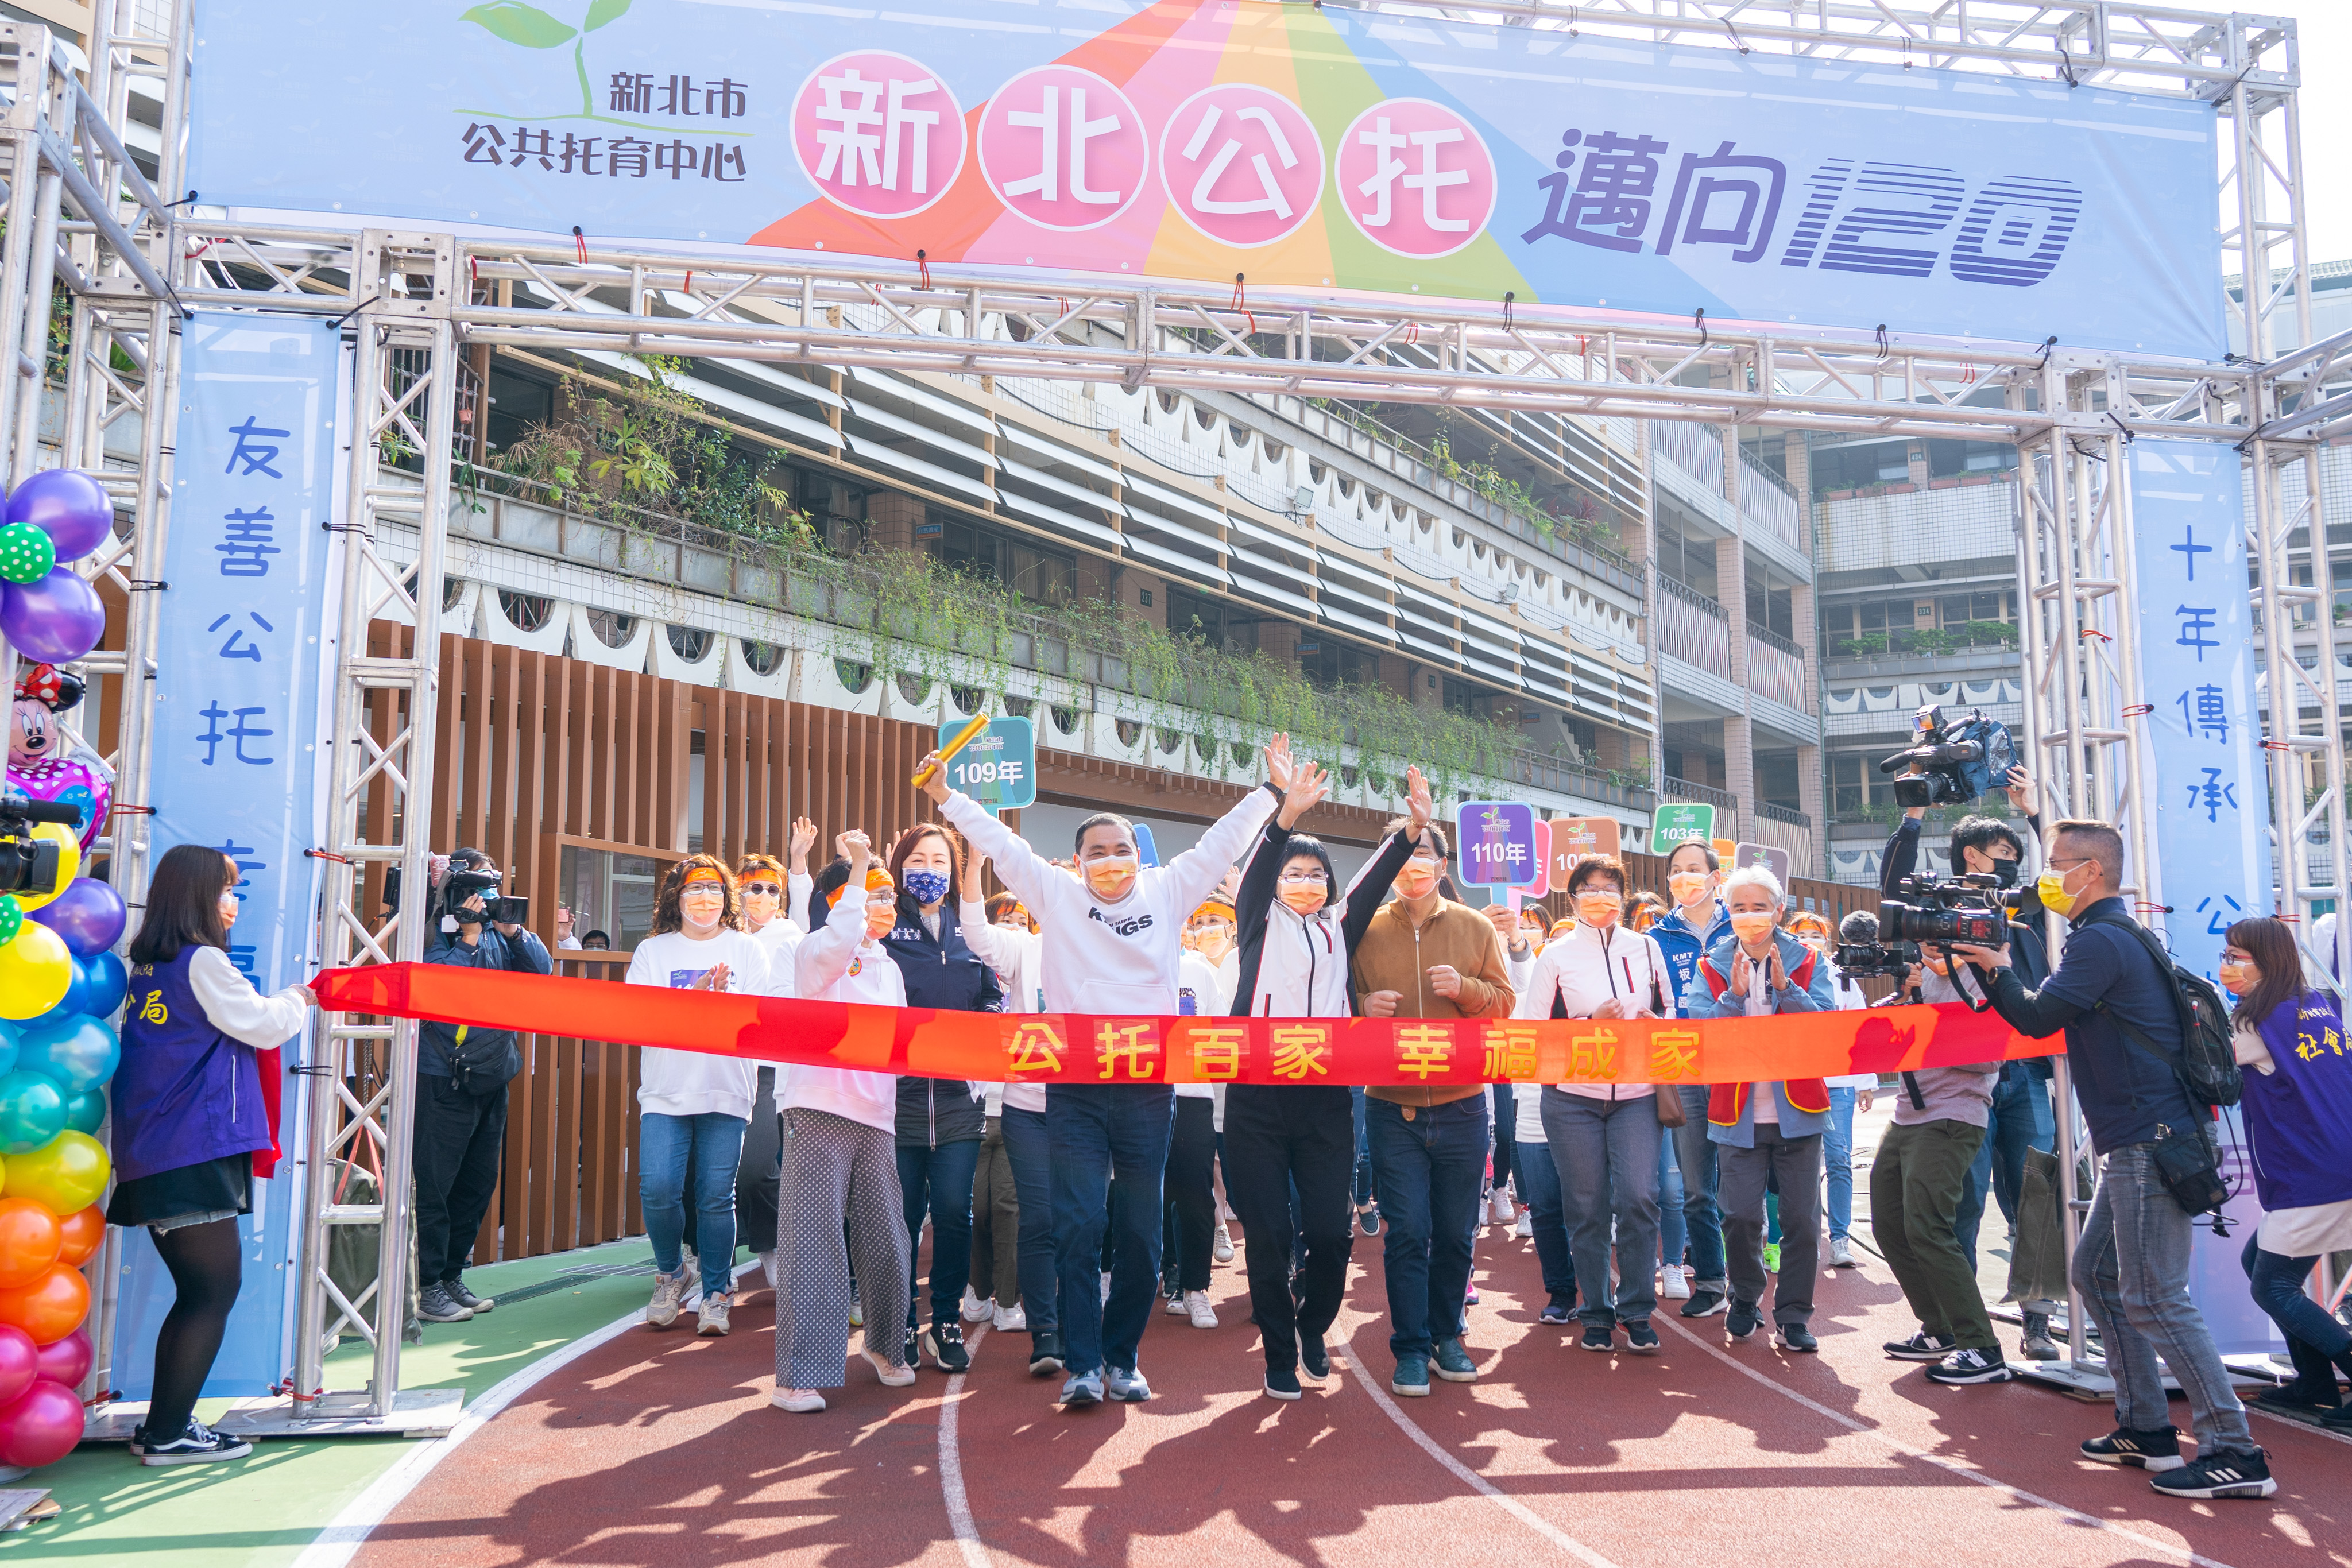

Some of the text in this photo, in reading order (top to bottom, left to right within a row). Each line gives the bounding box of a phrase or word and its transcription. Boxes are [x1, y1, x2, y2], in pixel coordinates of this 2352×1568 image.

[609, 71, 749, 119] 新北市
[461, 121, 748, 183] 公共托育中心
[814, 68, 1472, 232] 新北公托
[195, 415, 291, 766] 友善公托
[1142, 591, 1151, 605] 237
[2169, 525, 2238, 823] 十年傳承
[954, 760, 1024, 785] 109年
[1471, 842, 1527, 866] 110年
[1115, 916, 1133, 926] TAIPEI
[1672, 951, 1693, 962] KMT
[1008, 1021, 1701, 1081] 公托百家 幸福成家
